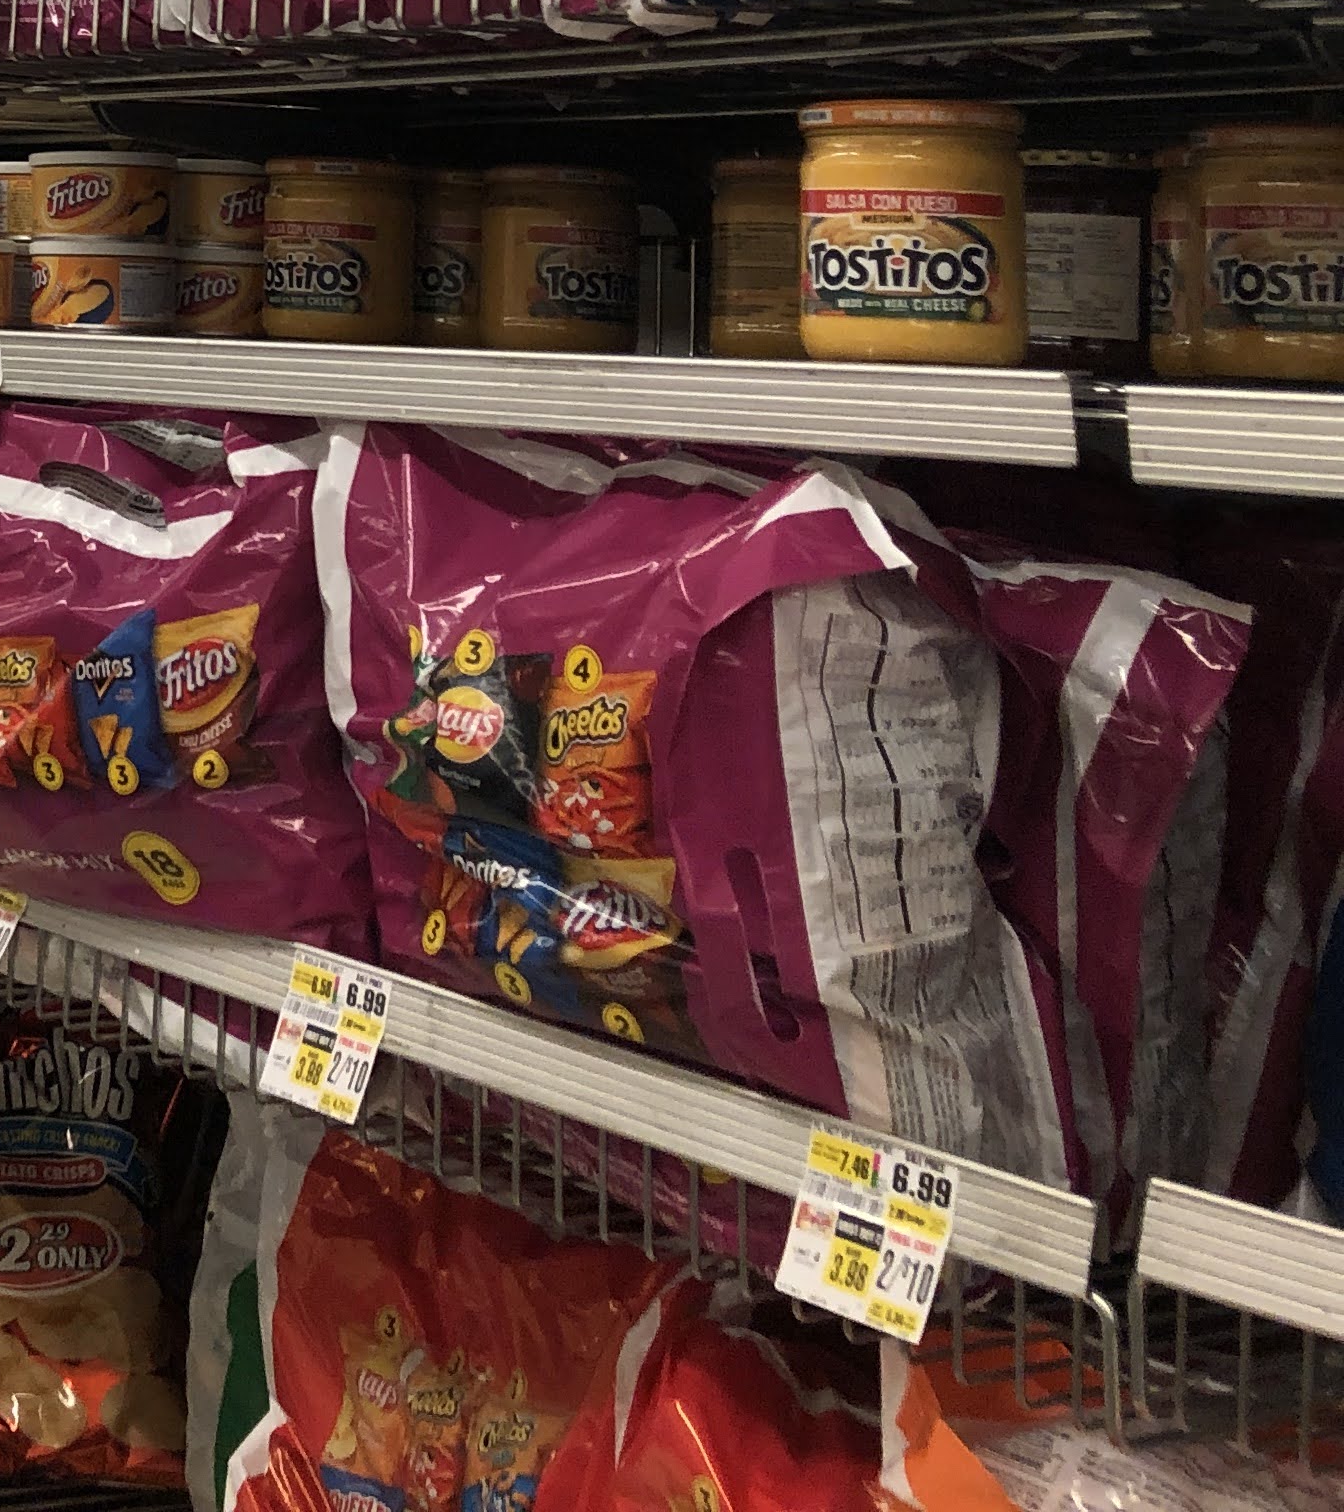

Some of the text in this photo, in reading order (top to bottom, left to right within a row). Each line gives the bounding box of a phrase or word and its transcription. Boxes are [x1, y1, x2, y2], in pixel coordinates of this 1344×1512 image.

[46, 174, 109, 215] Fritos
[825, 193, 957, 213] SALSA CON QUESO
[220, 189, 264, 225] Frit
[861, 213, 915, 226] MEDIUM
[912, 298, 968, 313] CHEESE
[466, 641, 483, 664] 3
[74, 655, 135, 681] Doritos
[159, 640, 238, 707] Fritos
[573, 659, 590, 680] 4
[546, 696, 629, 759] Cheetos
[43, 763, 55, 782] 3
[117, 767, 128, 786] 3
[204, 760, 217, 780] 2
[134, 848, 183, 878] 18
[429, 922, 441, 943] 3
[347, 983, 387, 1017] 6.99
[42, 1163, 96, 1180] CRISPS
[892, 1163, 952, 1208] 6.99
[37, 1245, 108, 1270] ONLY
[830, 1254, 869, 1292] 3.98
